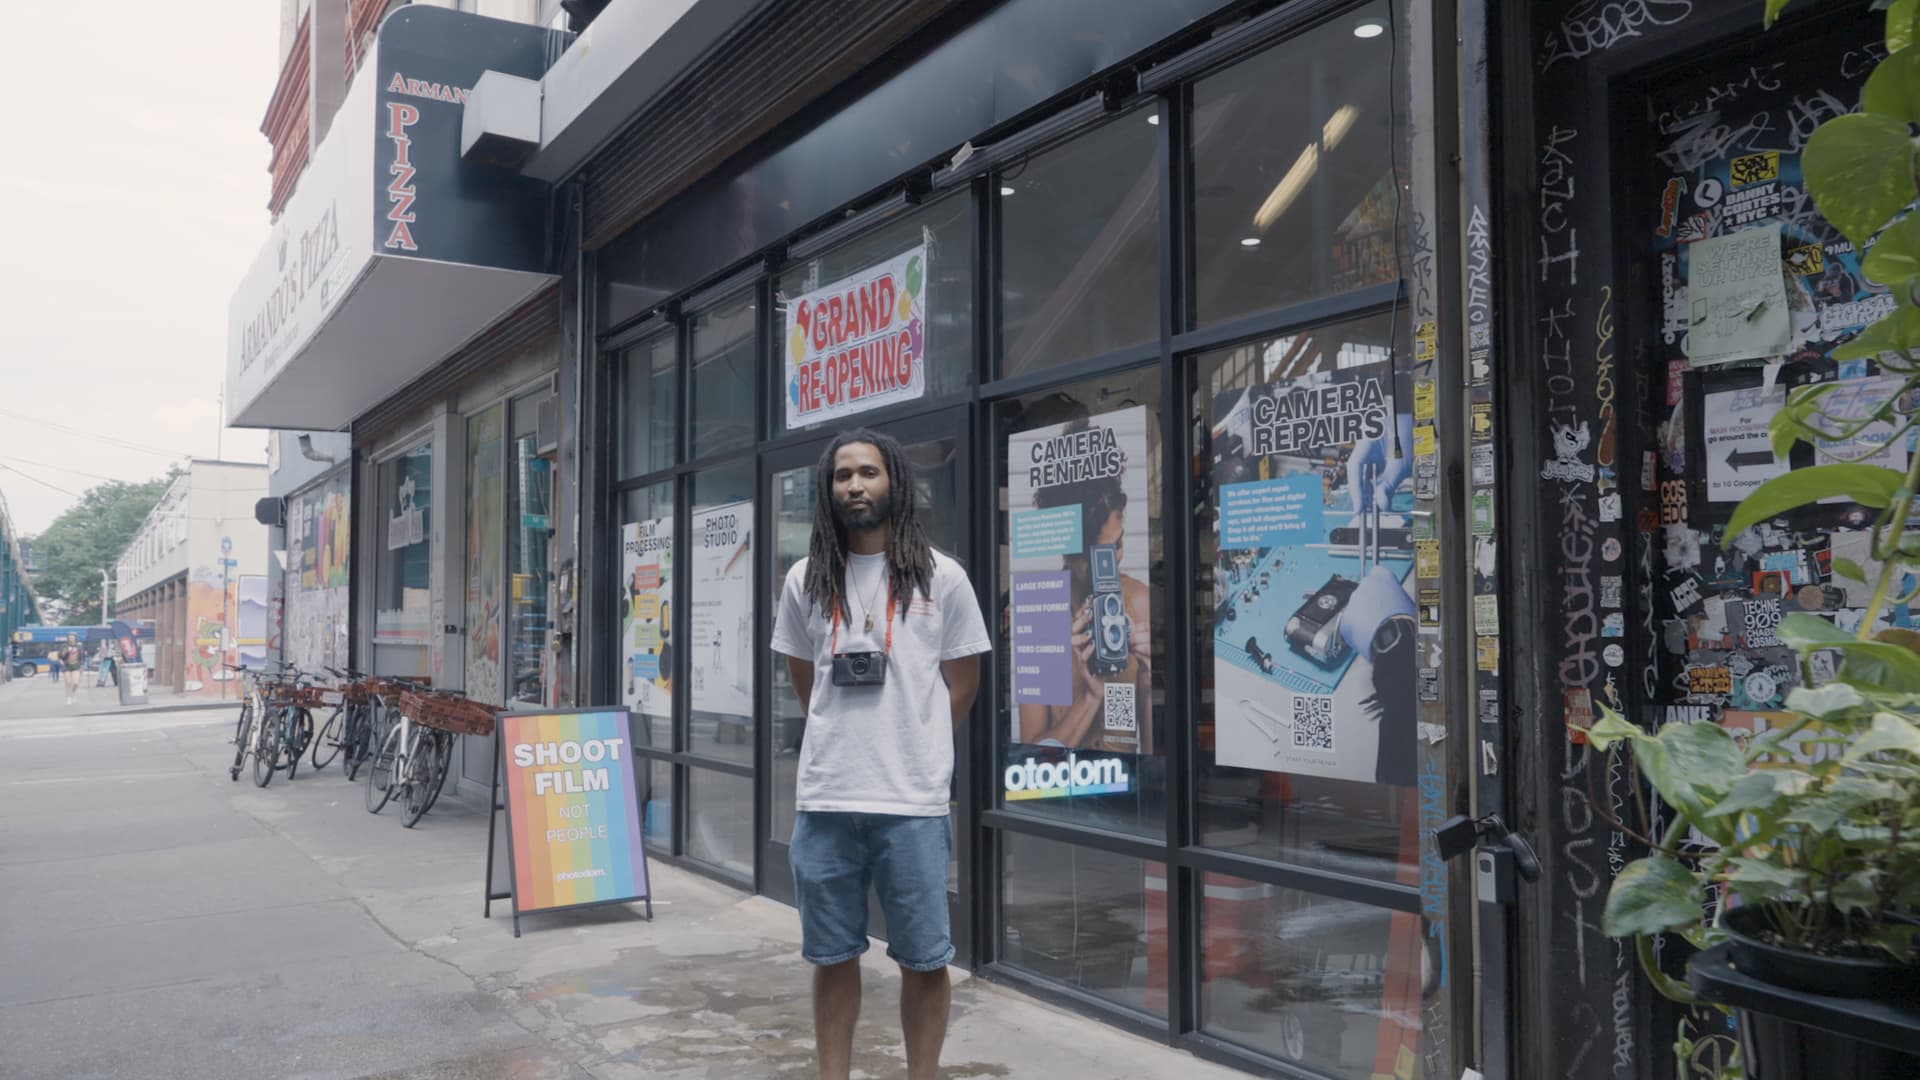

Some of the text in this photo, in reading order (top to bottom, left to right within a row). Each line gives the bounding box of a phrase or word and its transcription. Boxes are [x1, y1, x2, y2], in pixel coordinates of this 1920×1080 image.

[385, 102, 420, 251] PIZZA
[1722, 193, 1781, 217] CORTES
[1725, 183, 1777, 206] DANNY
[1736, 209, 1768, 223] NYC
[299, 198, 340, 302] PIZZA
[812, 274, 896, 351] GRAND
[798, 329, 913, 414] RE-OPENING
[1254, 378, 1385, 425] CAMERA
[1254, 409, 1385, 455] REPAIRS
[1031, 428, 1118, 464] CAMERA
[1029, 451, 1121, 488] RENTALS
[639, 523, 656, 538] FILM
[705, 514, 736, 531] PHOTO
[625, 535, 672, 554] PROCESSING
[704, 530, 738, 548] STUDIO
[1037, 580, 1064, 589] FORMAT
[1042, 603, 1069, 611] FORMAT
[1742, 599, 1782, 615] TECHNE
[1017, 645, 1065, 653] VIDEO CAMERAS
[513, 738, 624, 768] SHOOT
[534, 768, 610, 796] FILM
[559, 804, 591, 819] NOT
[546, 824, 608, 843] PEOPLE
